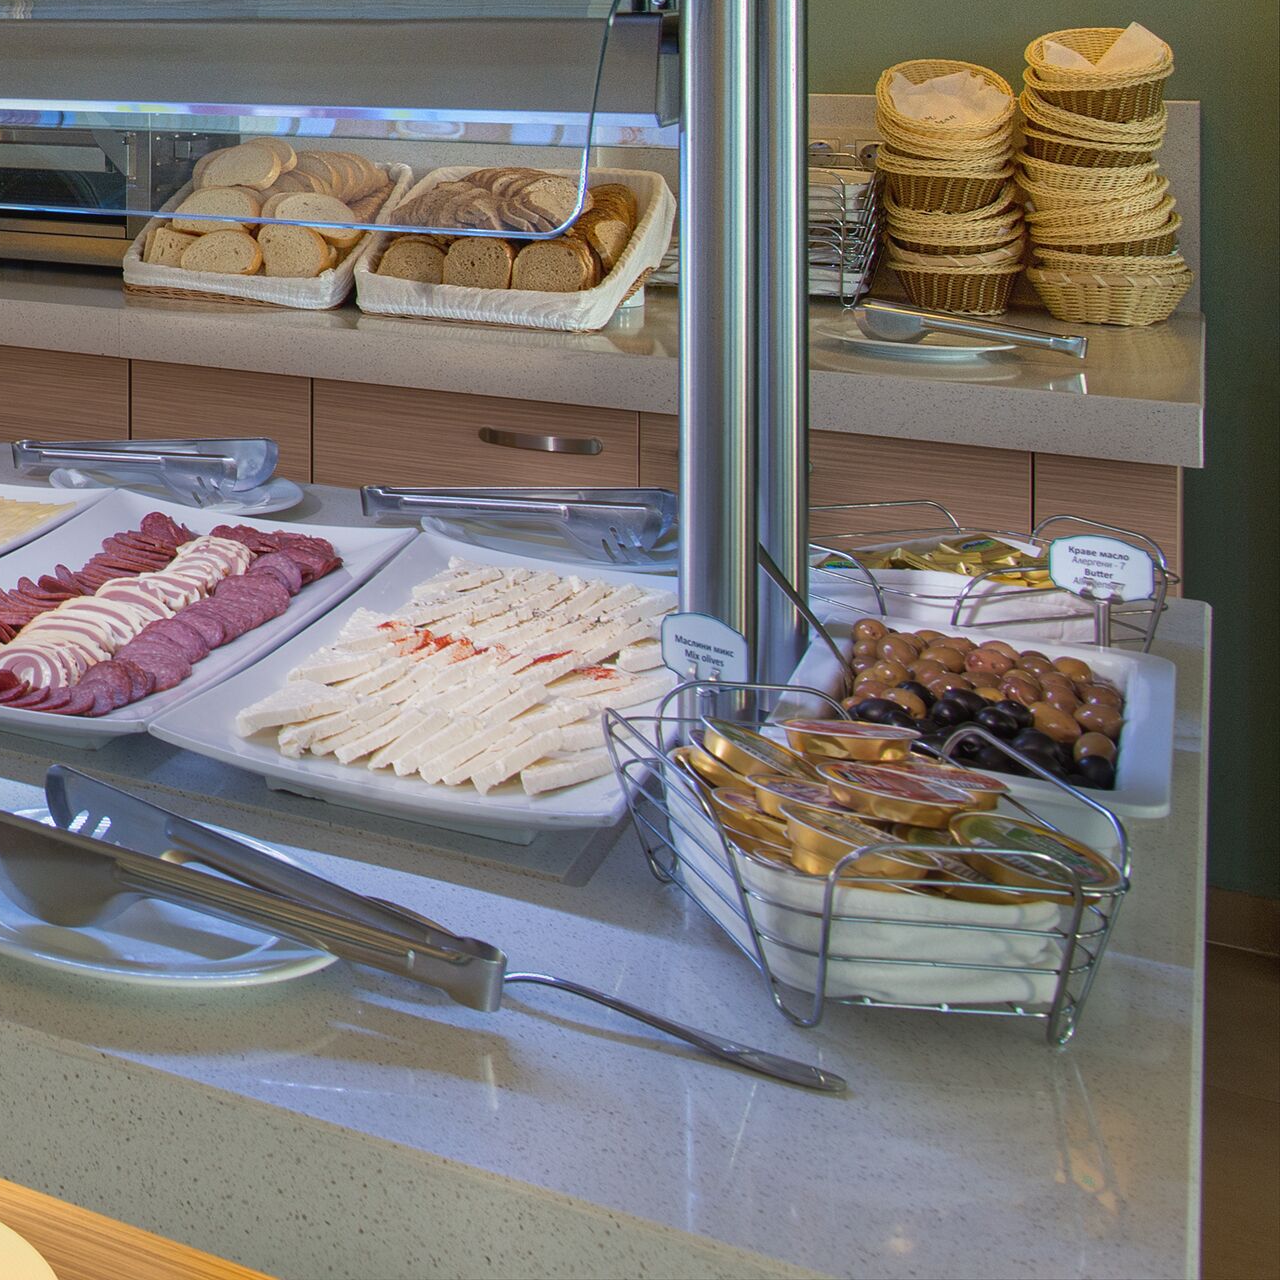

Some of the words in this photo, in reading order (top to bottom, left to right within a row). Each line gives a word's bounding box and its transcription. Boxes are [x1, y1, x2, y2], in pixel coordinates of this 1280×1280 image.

[1068, 545, 1097, 557] Краве
[1099, 551, 1130, 561] масло
[1071, 556, 1113, 569] Алергени
[1084, 568, 1114, 579] Butter
[675, 634, 712, 652] Маслини
[713, 646, 735, 658] микс
[684, 649, 701, 661] Mix
[701, 654, 725, 667] olives
